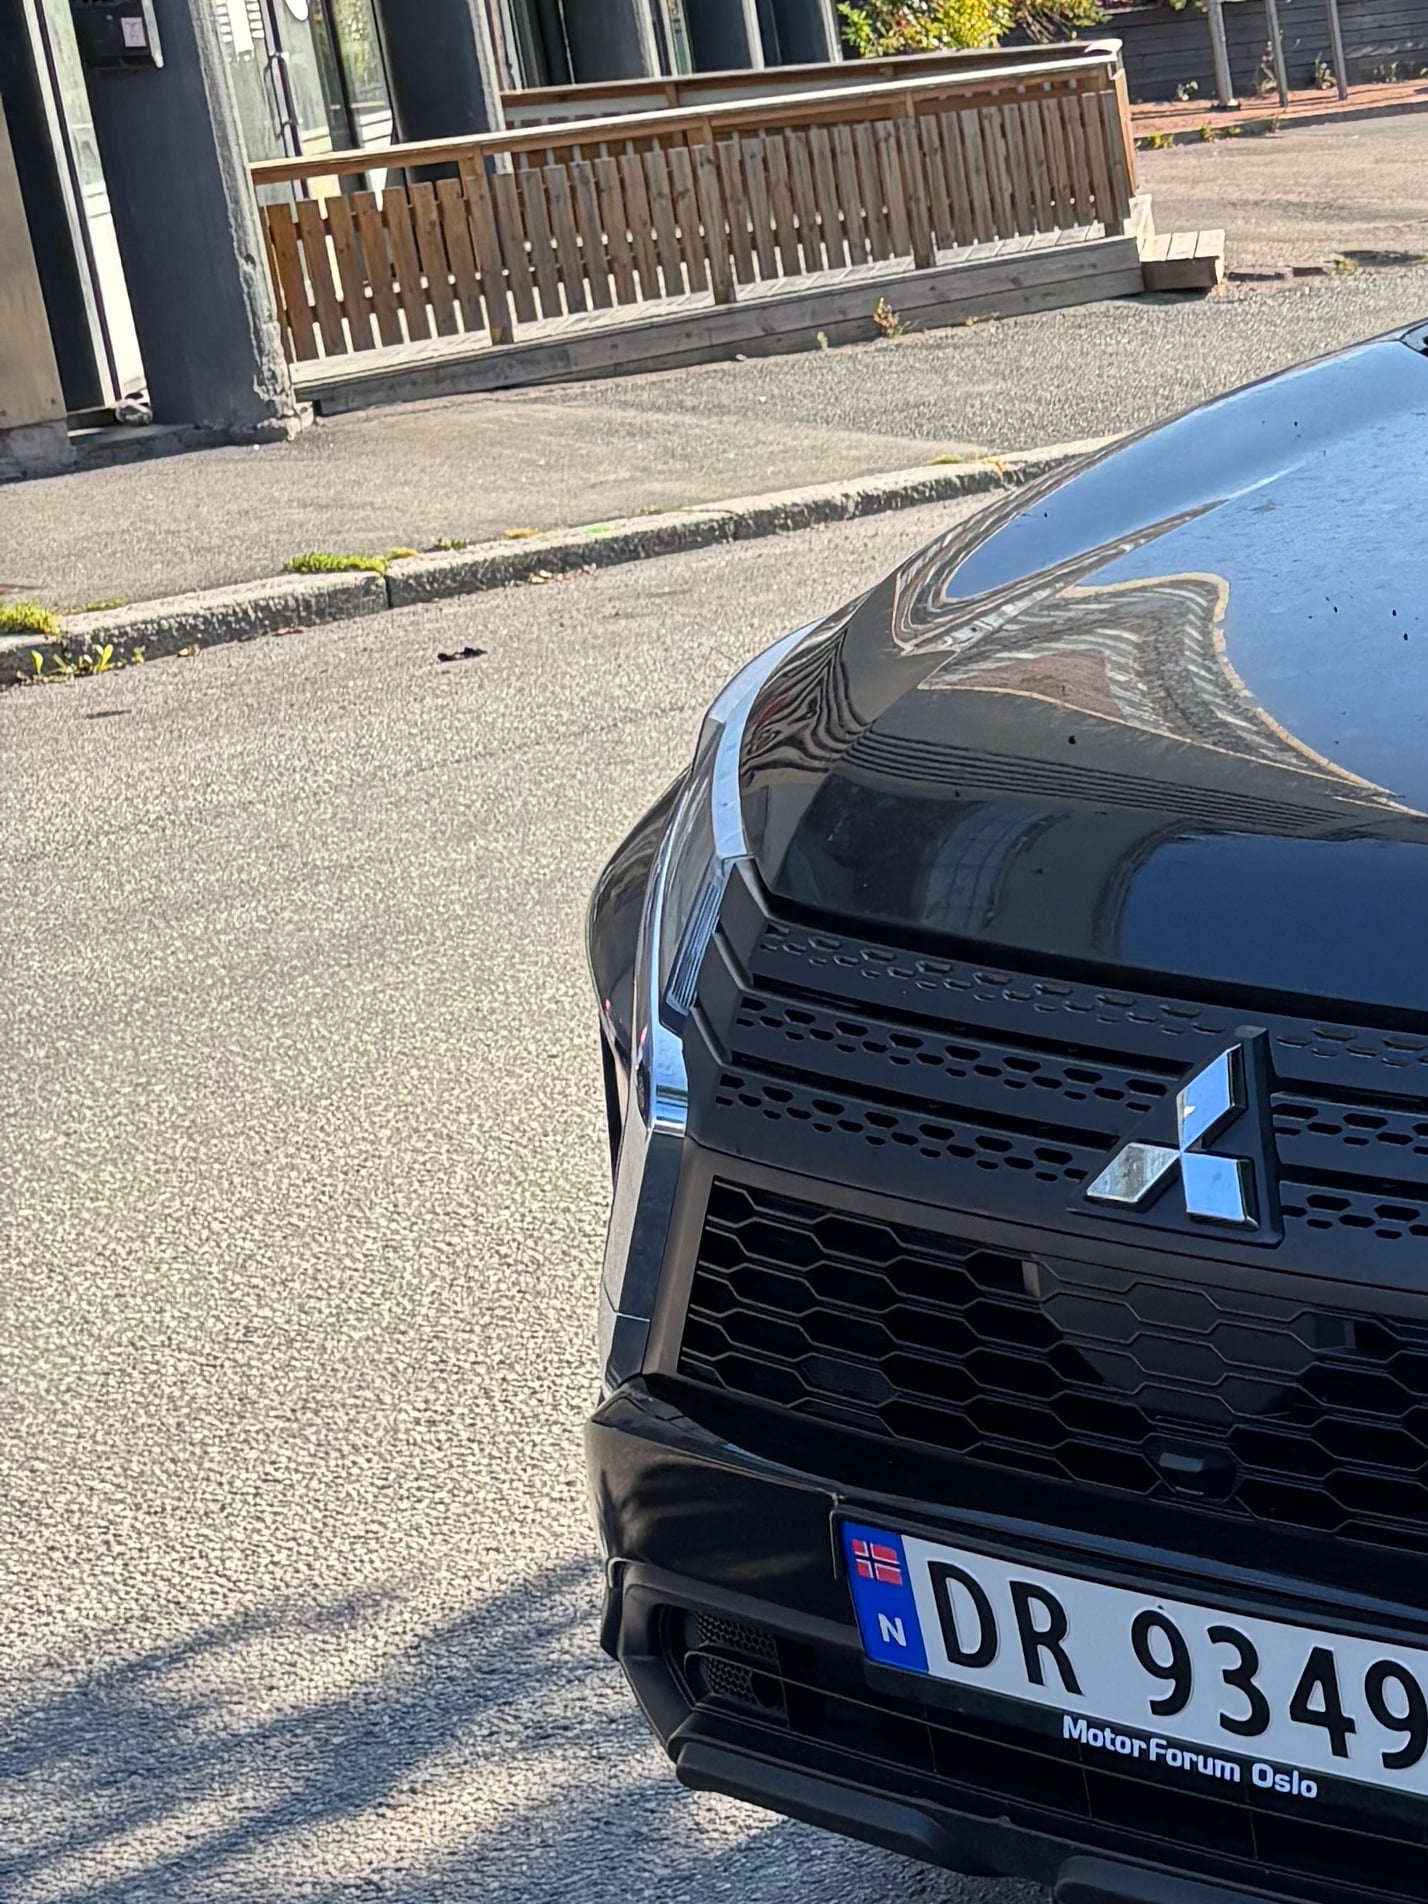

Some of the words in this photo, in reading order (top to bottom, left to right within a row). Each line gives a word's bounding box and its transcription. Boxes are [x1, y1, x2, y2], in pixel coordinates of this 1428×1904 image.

[878, 1612, 907, 1647] N
[926, 1559, 1084, 1697] DR
[1251, 1761, 1319, 1799] Oslo
